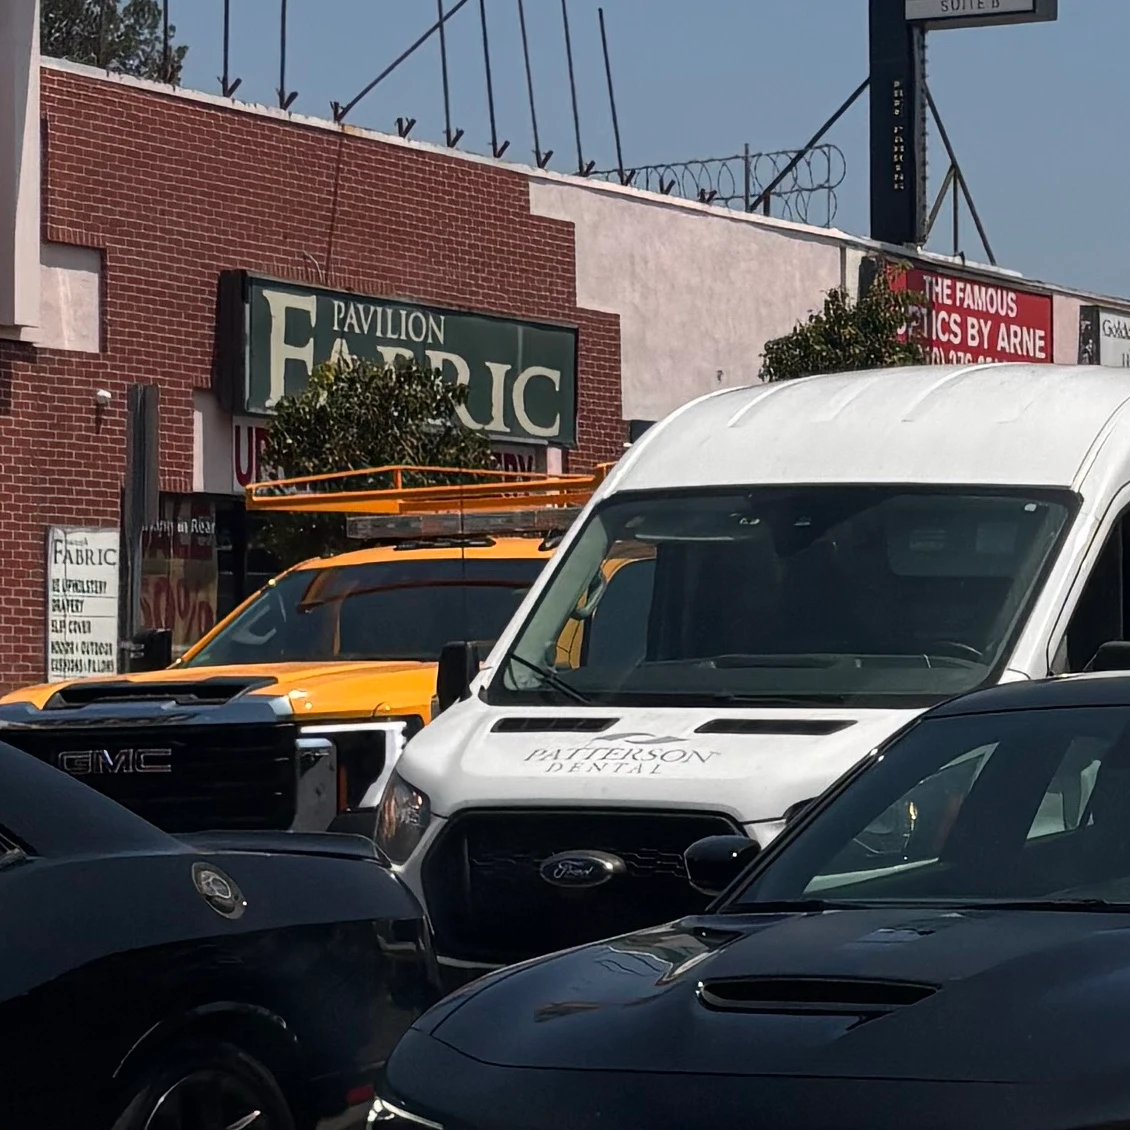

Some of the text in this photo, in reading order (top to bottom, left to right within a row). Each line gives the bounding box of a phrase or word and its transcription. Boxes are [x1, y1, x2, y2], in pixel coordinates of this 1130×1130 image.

[923, 275, 1018, 318] THE FAMOUS
[332, 301, 445, 345] PAVILION
[896, 304, 962, 345] PTICS
[967, 316, 992, 349] BY
[997, 323, 1047, 359] ARNE
[262, 290, 561, 437] FRIC
[53, 538, 118, 566] FABRIC
[58, 748, 172, 775] GMC
[524, 747, 716, 764] PATTERSON
[545, 762, 663, 775] DENTAL
[553, 859, 594, 880] Ford
